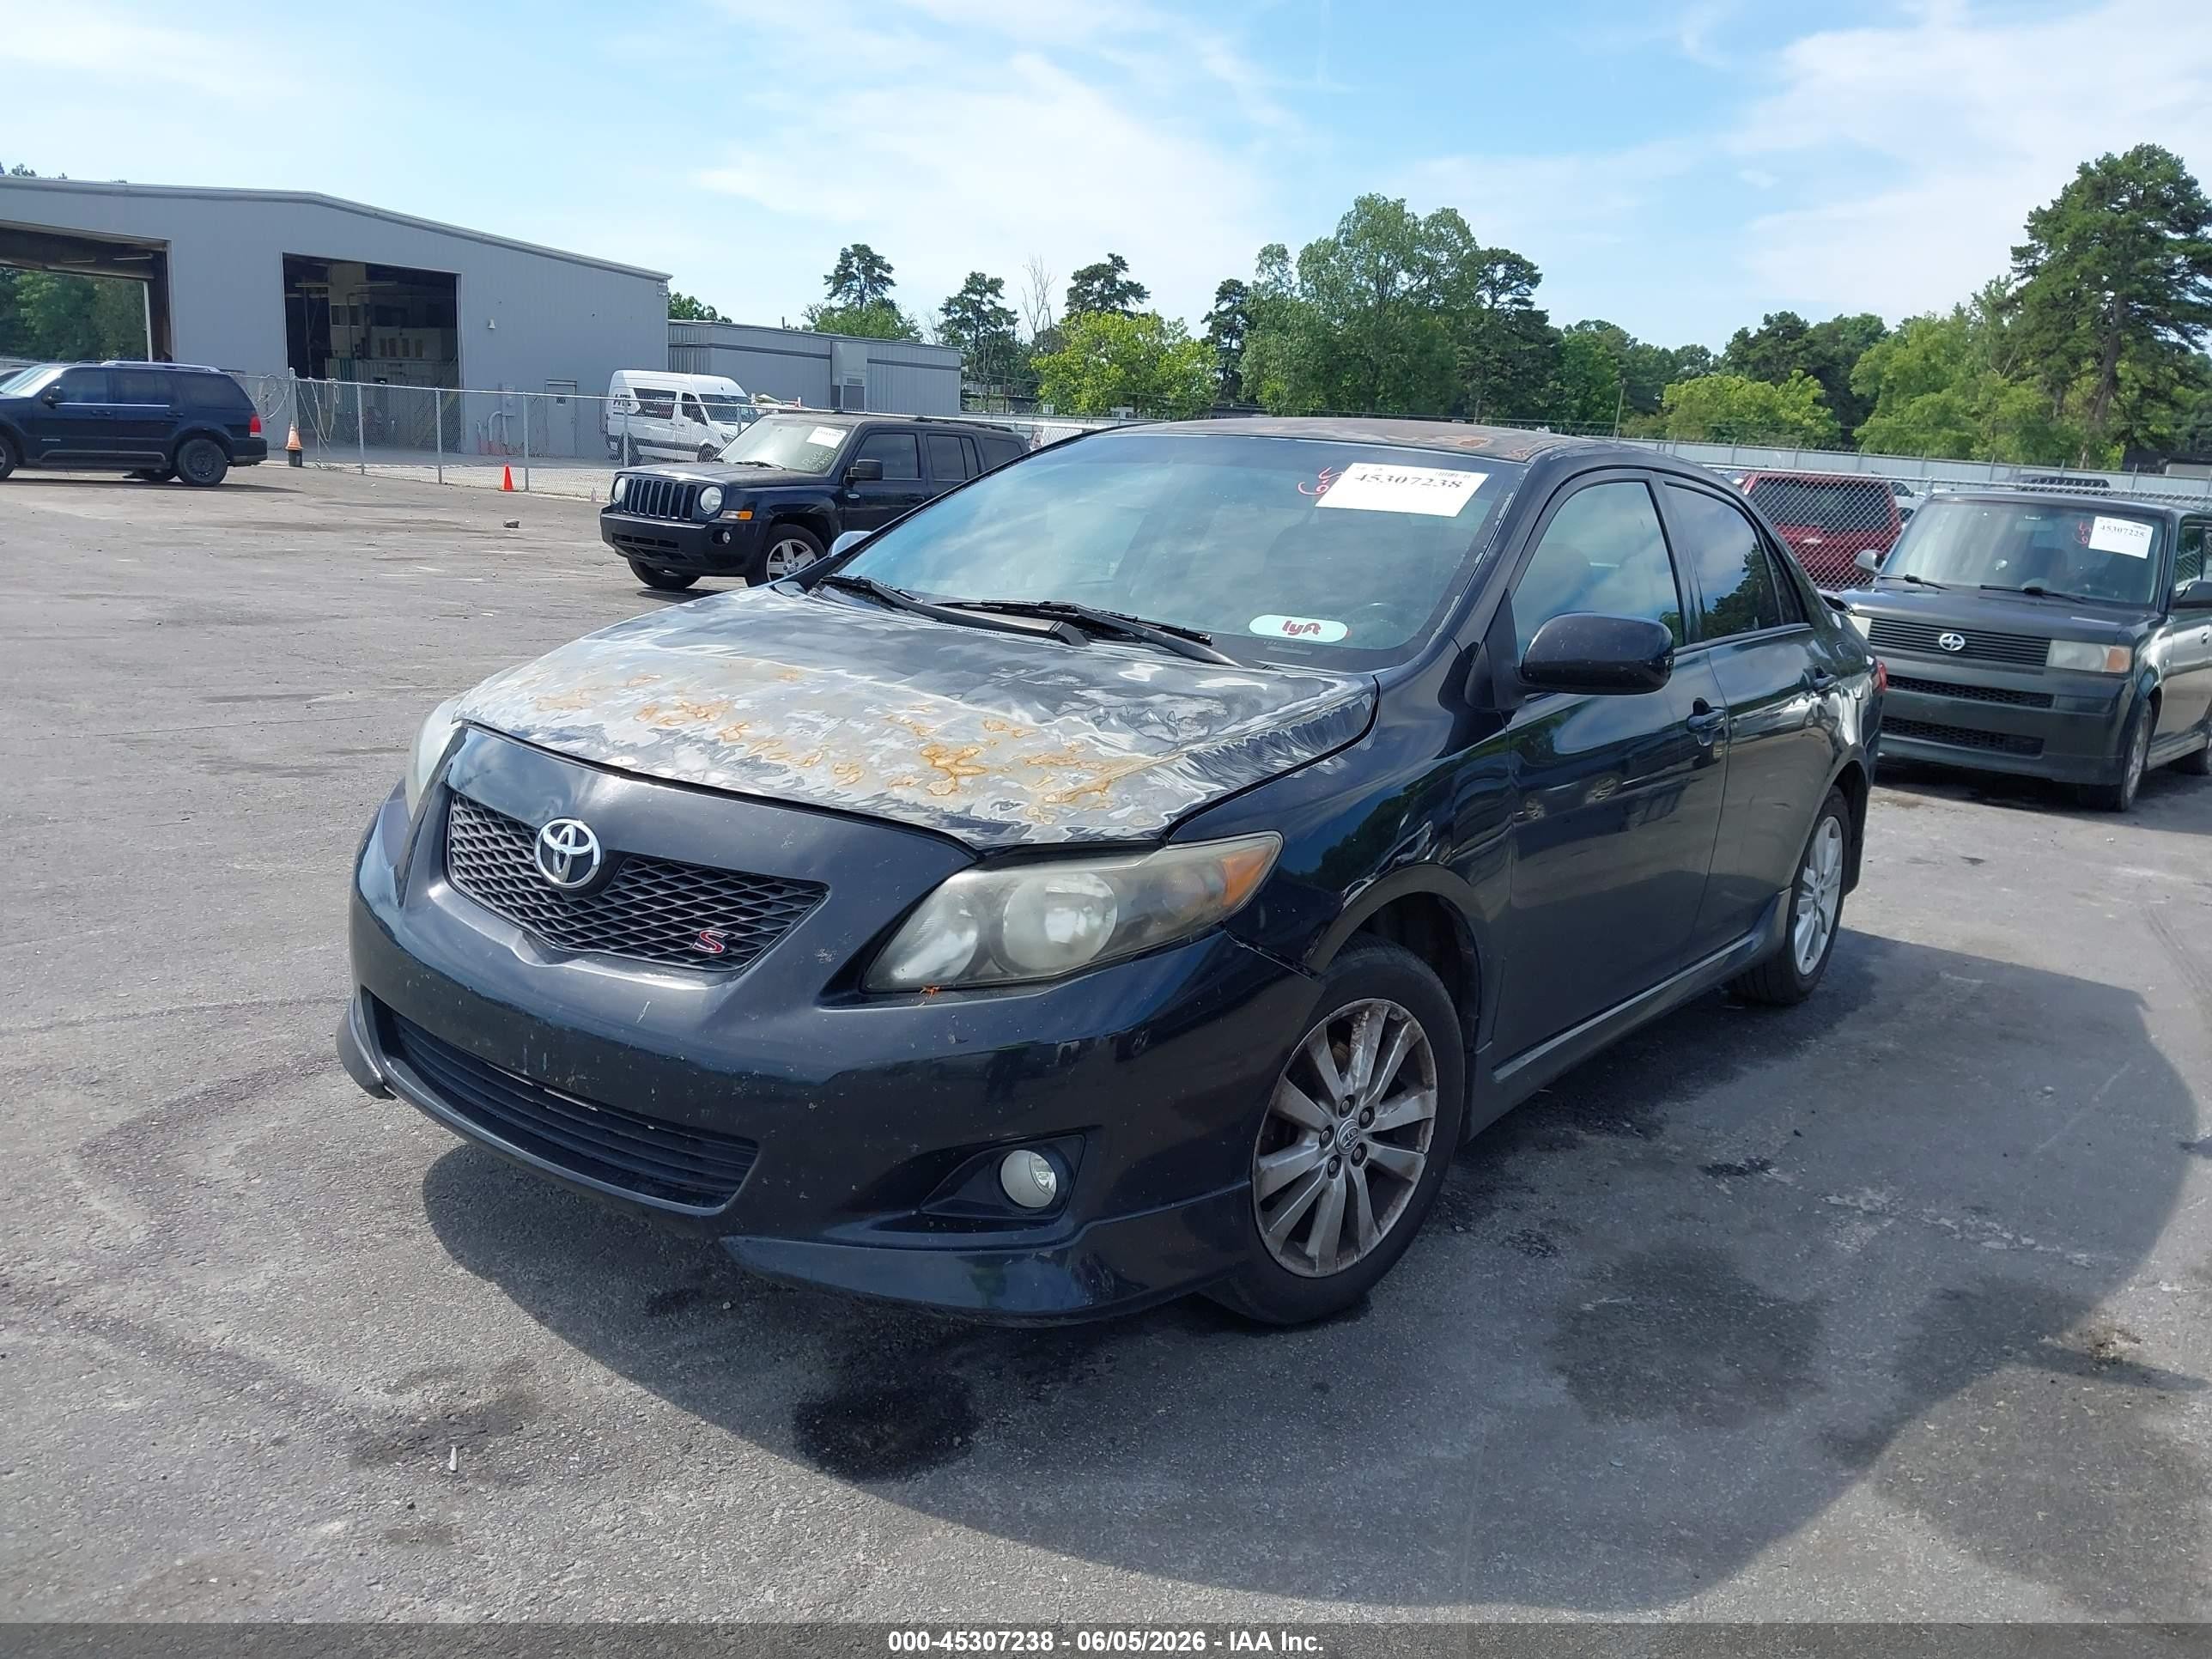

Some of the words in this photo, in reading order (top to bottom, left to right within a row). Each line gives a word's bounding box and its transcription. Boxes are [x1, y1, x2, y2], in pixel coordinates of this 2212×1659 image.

[1354, 473, 1462, 488] 45307238
[1282, 620, 1321, 636] lyft
[691, 929, 728, 953] S
